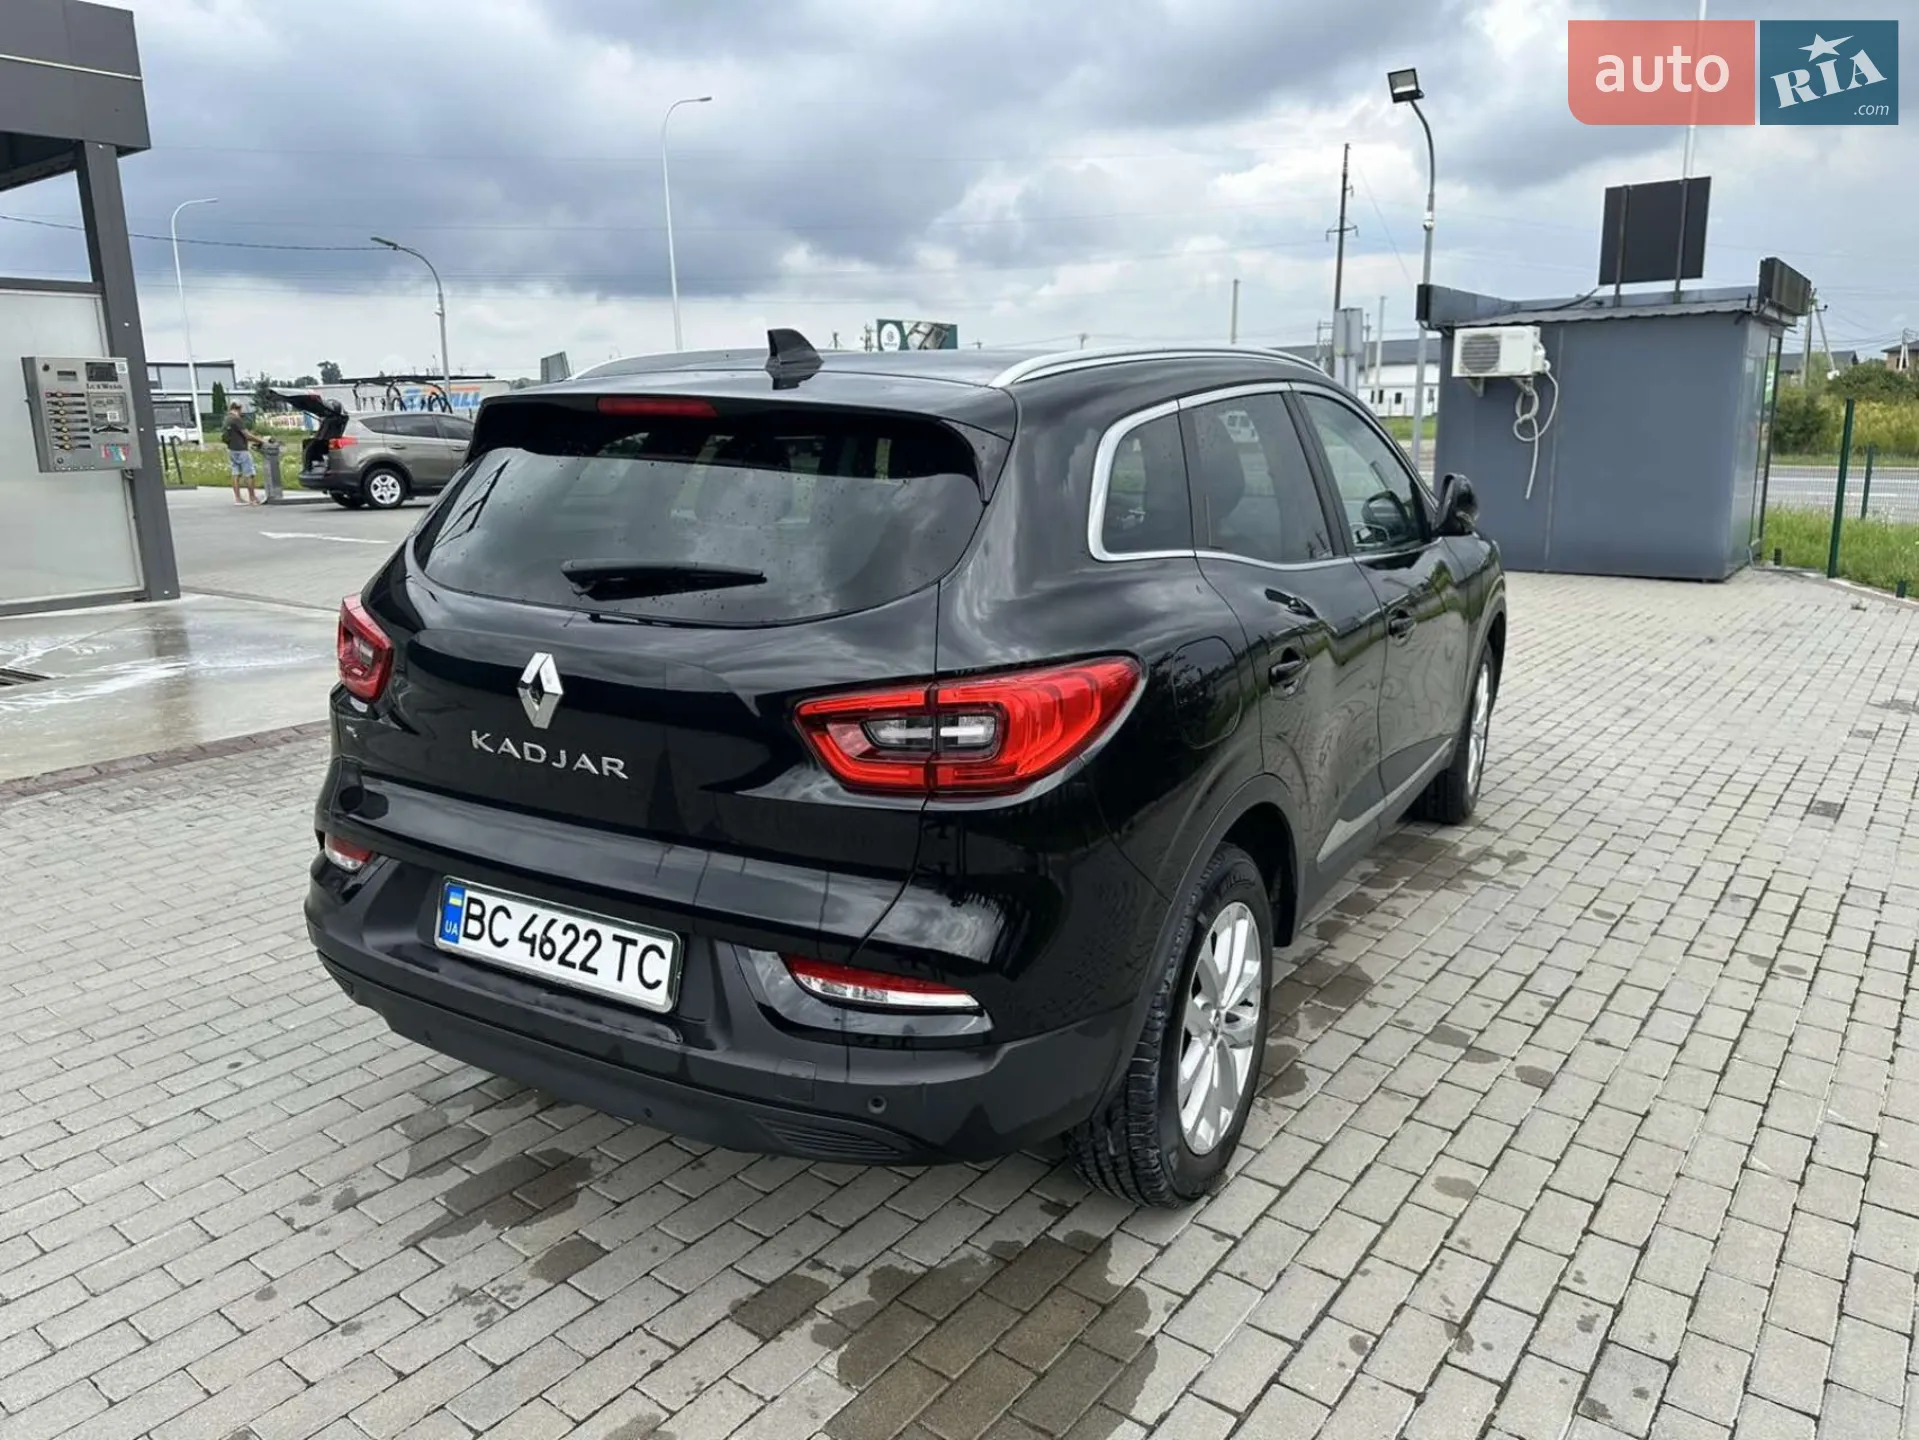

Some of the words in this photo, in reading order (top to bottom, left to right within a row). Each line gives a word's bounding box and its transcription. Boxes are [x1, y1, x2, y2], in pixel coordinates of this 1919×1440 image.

[471, 730, 629, 780] KADJAR
[444, 920, 459, 936] UA
[462, 896, 512, 948] BC
[518, 914, 602, 976] 4622
[612, 934, 666, 990] TC
